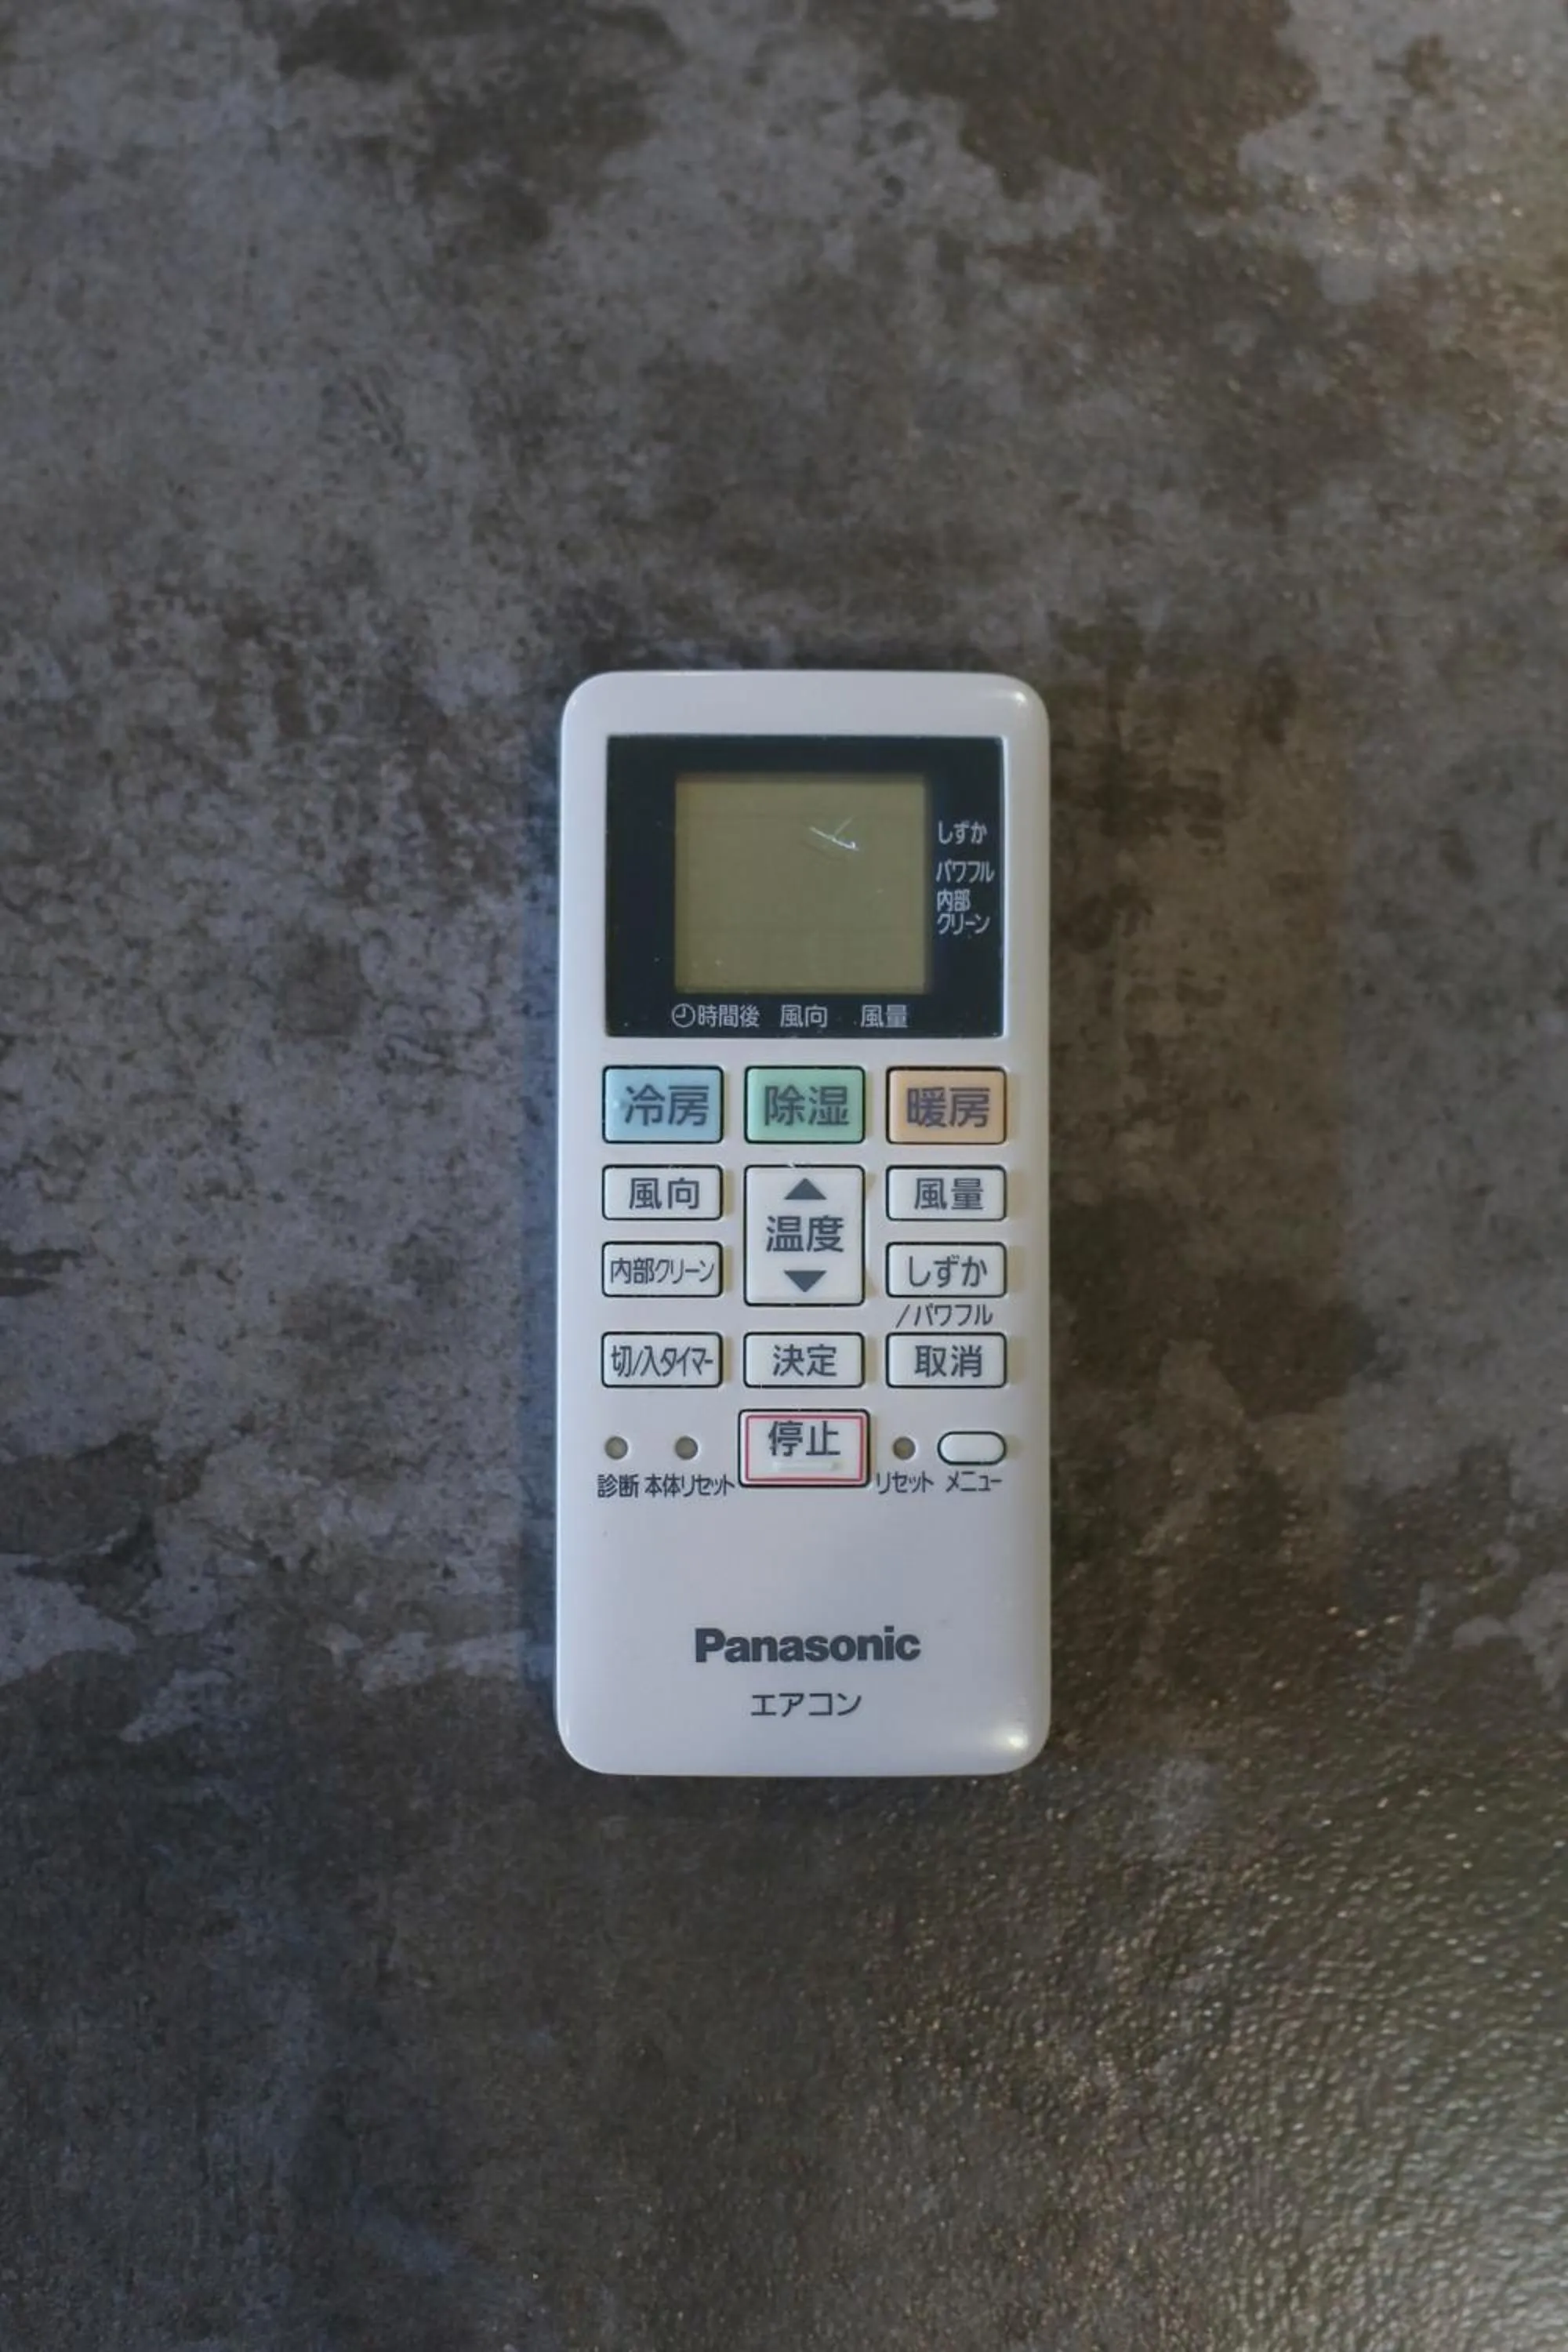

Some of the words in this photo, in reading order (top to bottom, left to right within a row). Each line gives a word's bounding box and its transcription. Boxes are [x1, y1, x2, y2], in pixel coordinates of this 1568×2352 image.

[938, 821, 987, 844] しずか
[936, 860, 994, 884] パワフル
[937, 890, 970, 911] 内部
[937, 913, 990, 935] クリーン
[781, 1006, 827, 1029] 風向
[861, 1006, 908, 1029] 風量
[624, 1083, 710, 1127] 冷房
[764, 1085, 849, 1127] 除湿
[906, 1086, 989, 1127] 暖房
[628, 1178, 699, 1210] 風向
[914, 1178, 983, 1211] 風量
[766, 1215, 844, 1253] 温度
[610, 1257, 714, 1285] 内部クリーン
[908, 1256, 987, 1288] しずか
[612, 1346, 713, 1377] 切/入タイマー
[773, 1345, 837, 1377] 決定
[915, 1345, 982, 1377] 取消
[768, 1421, 841, 1457] 停止
[597, 1474, 638, 1498] 診断
[644, 1474, 735, 1497] 本体リセット
[877, 1472, 934, 1494] リセット
[946, 1472, 1003, 1493] メニュー
[695, 1625, 920, 1663] Panasonic
[750, 1693, 861, 1717] エアコン
